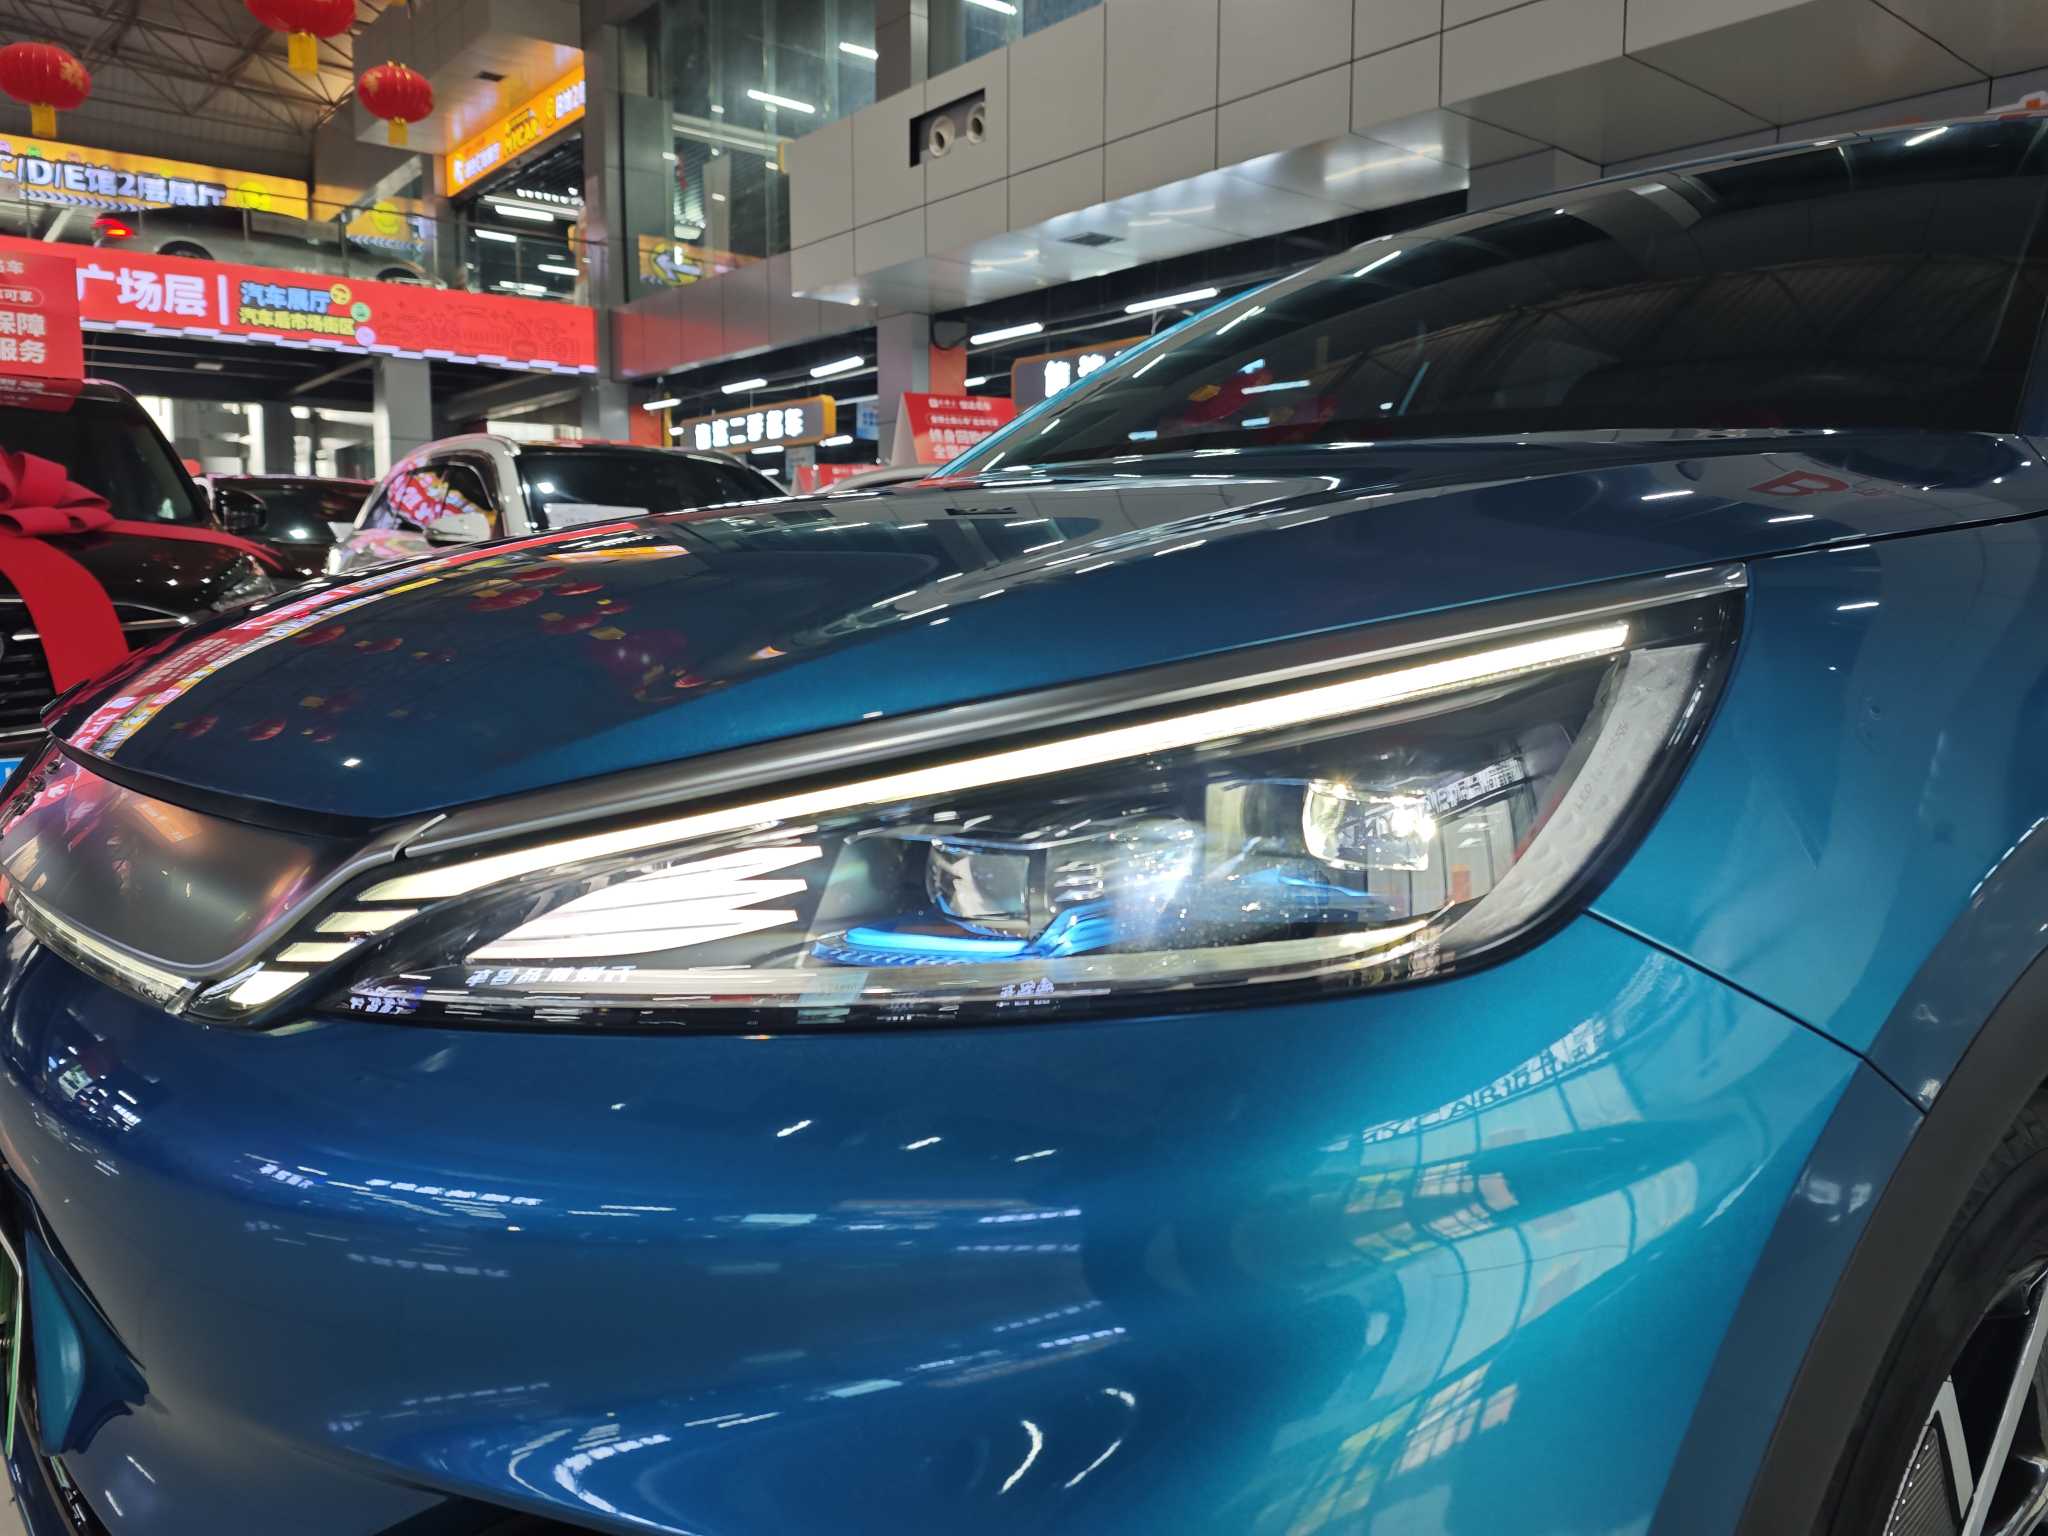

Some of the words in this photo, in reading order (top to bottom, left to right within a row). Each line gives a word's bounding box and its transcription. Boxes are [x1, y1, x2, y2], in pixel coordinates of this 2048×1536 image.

[76, 264, 207, 318] 广场层
[240, 280, 331, 314] 汽车展厅
[239, 307, 356, 336] 汽车后市场街区
